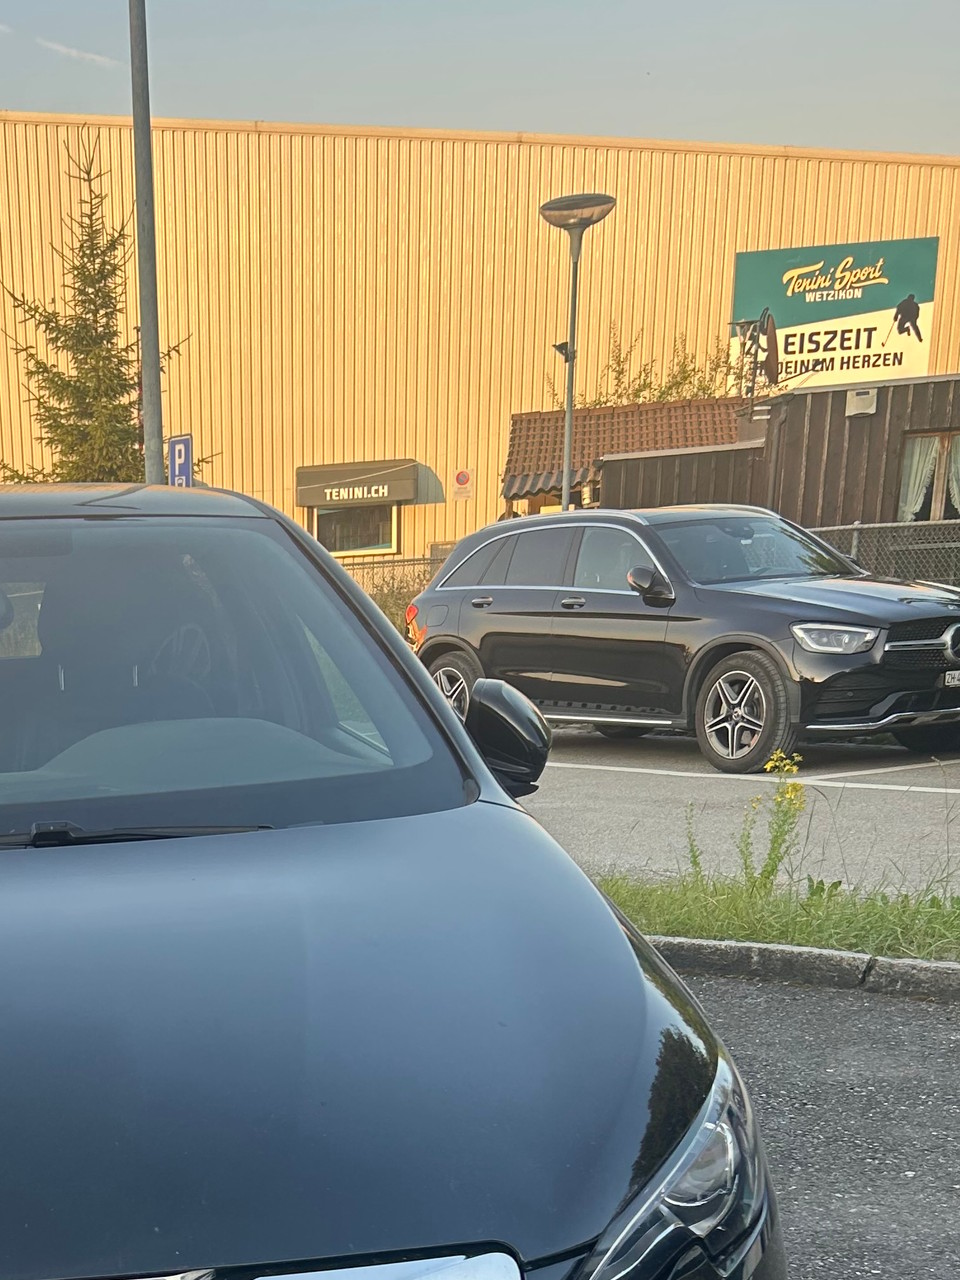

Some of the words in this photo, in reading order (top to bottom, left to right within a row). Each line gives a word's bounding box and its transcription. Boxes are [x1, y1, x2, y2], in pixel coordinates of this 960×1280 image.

[782, 260, 833, 297] Tenini
[834, 256, 889, 291] Sport
[805, 287, 862, 303] WETZIKON
[783, 326, 878, 355] EISZEIT
[839, 351, 904, 371] HERZEN
[174, 443, 186, 476] P
[324, 484, 389, 501] TENINI.CH
